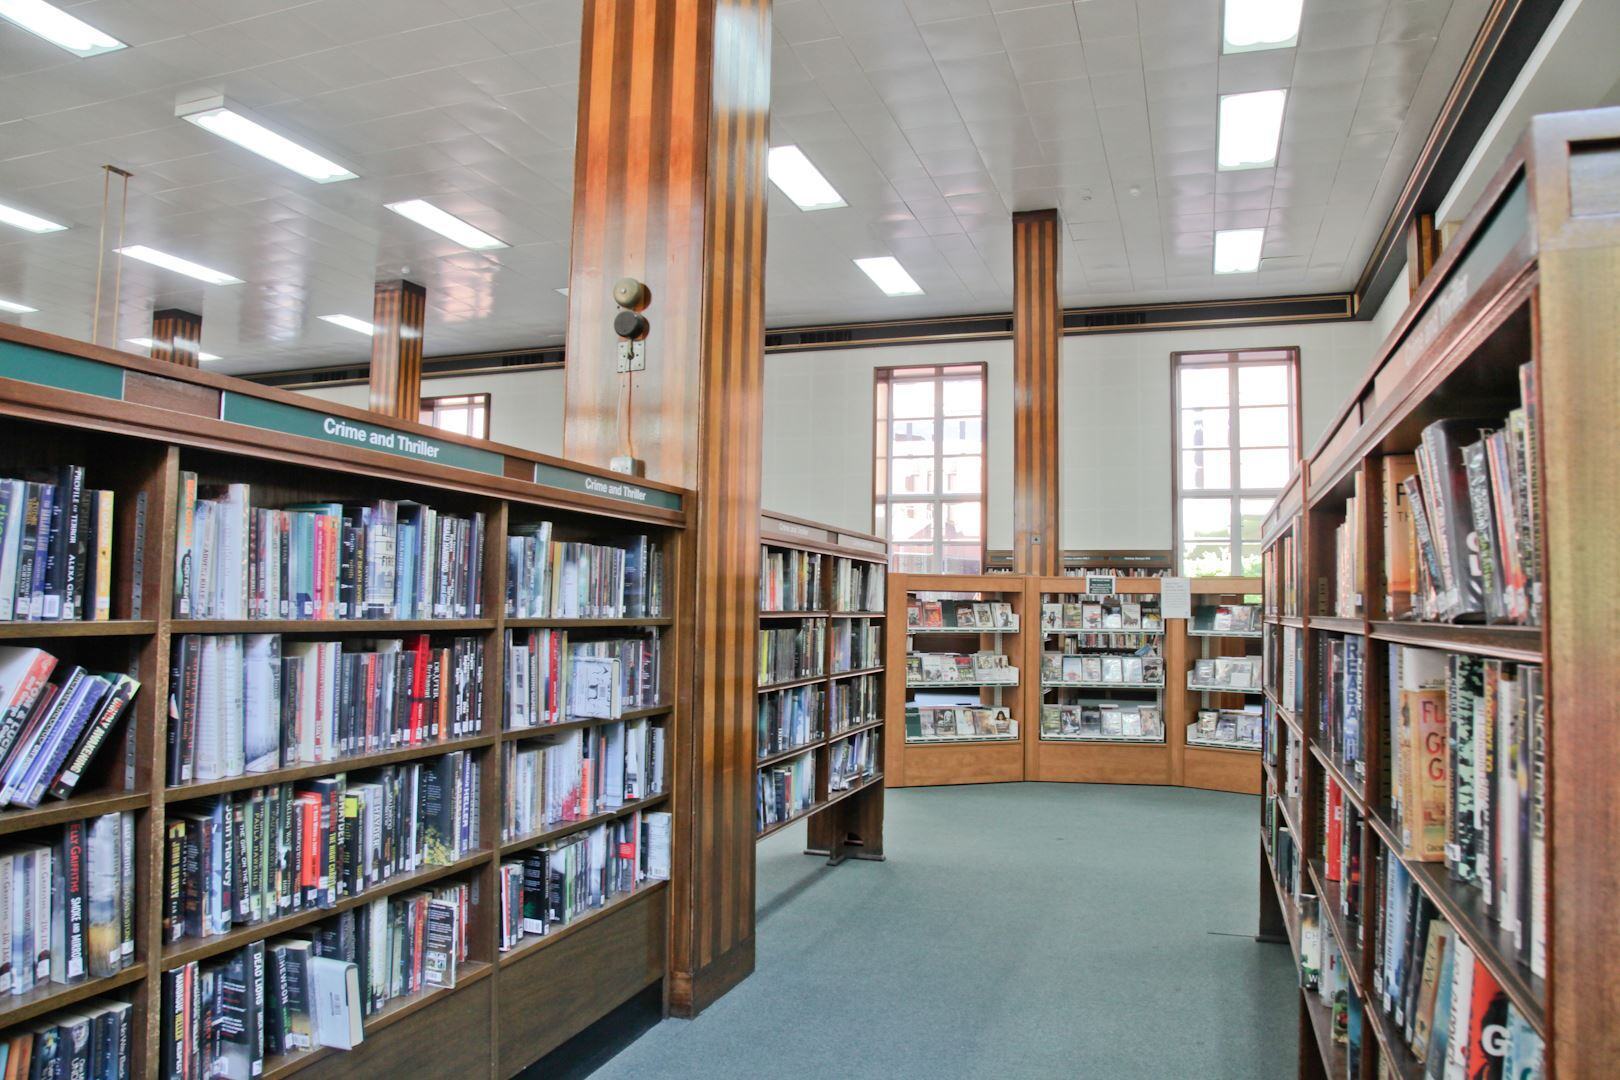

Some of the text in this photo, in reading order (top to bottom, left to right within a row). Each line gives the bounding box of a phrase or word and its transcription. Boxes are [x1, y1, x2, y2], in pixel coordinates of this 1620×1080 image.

[323, 418, 440, 458] Crime and Thriller
[72, 470, 81, 502] PROFILE
[585, 478, 646, 501] Crime and Thriller
[69, 514, 78, 543] TERROR
[67, 555, 76, 582] ALEXA
[71, 697, 124, 773] UNHOLY AWAKENING
[462, 788, 470, 827] HELLER
[373, 806, 381, 846] HAYDER
[70, 824, 81, 892] ELLY GRIFFITHS
[171, 841, 181, 865] JOHN
[223, 805, 233, 886] John Harvey
[241, 857, 248, 868] ON
[328, 845, 337, 863] NIGHT
[171, 866, 181, 899] HARVEY
[252, 845, 260, 886] HAWKINS
[70, 897, 81, 960] SMOKE AND MIRRO
[253, 952, 263, 976] DEAD
[279, 959, 289, 1004] HEWSON
[255, 978, 264, 1005] LIONS
[175, 973, 185, 1073] MANDASUE HELLER RESPECT
